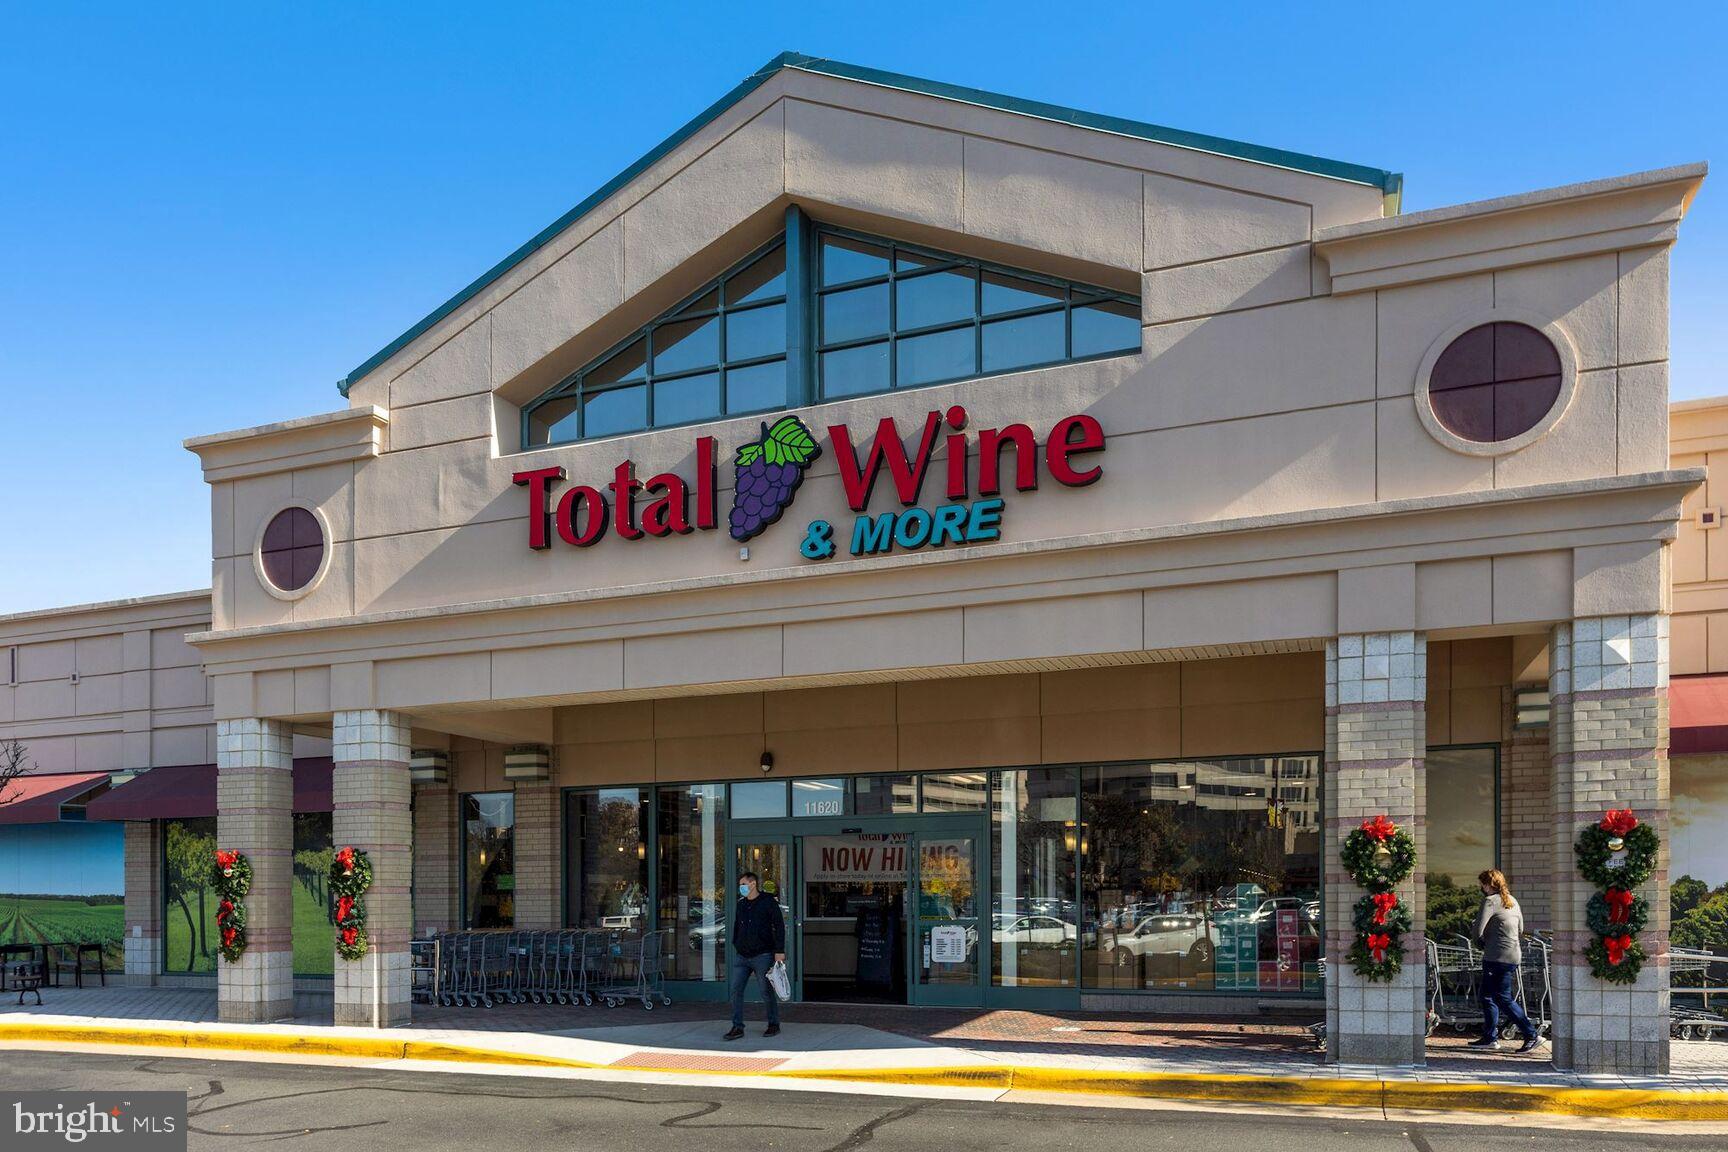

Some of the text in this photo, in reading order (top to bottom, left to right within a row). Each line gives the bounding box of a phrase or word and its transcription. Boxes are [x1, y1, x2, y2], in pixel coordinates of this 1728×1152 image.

[512, 404, 1107, 551] Total Wine
[800, 498, 1006, 560] & MORE
[804, 800, 839, 814] 11620
[822, 845, 960, 872] NOW HIING
